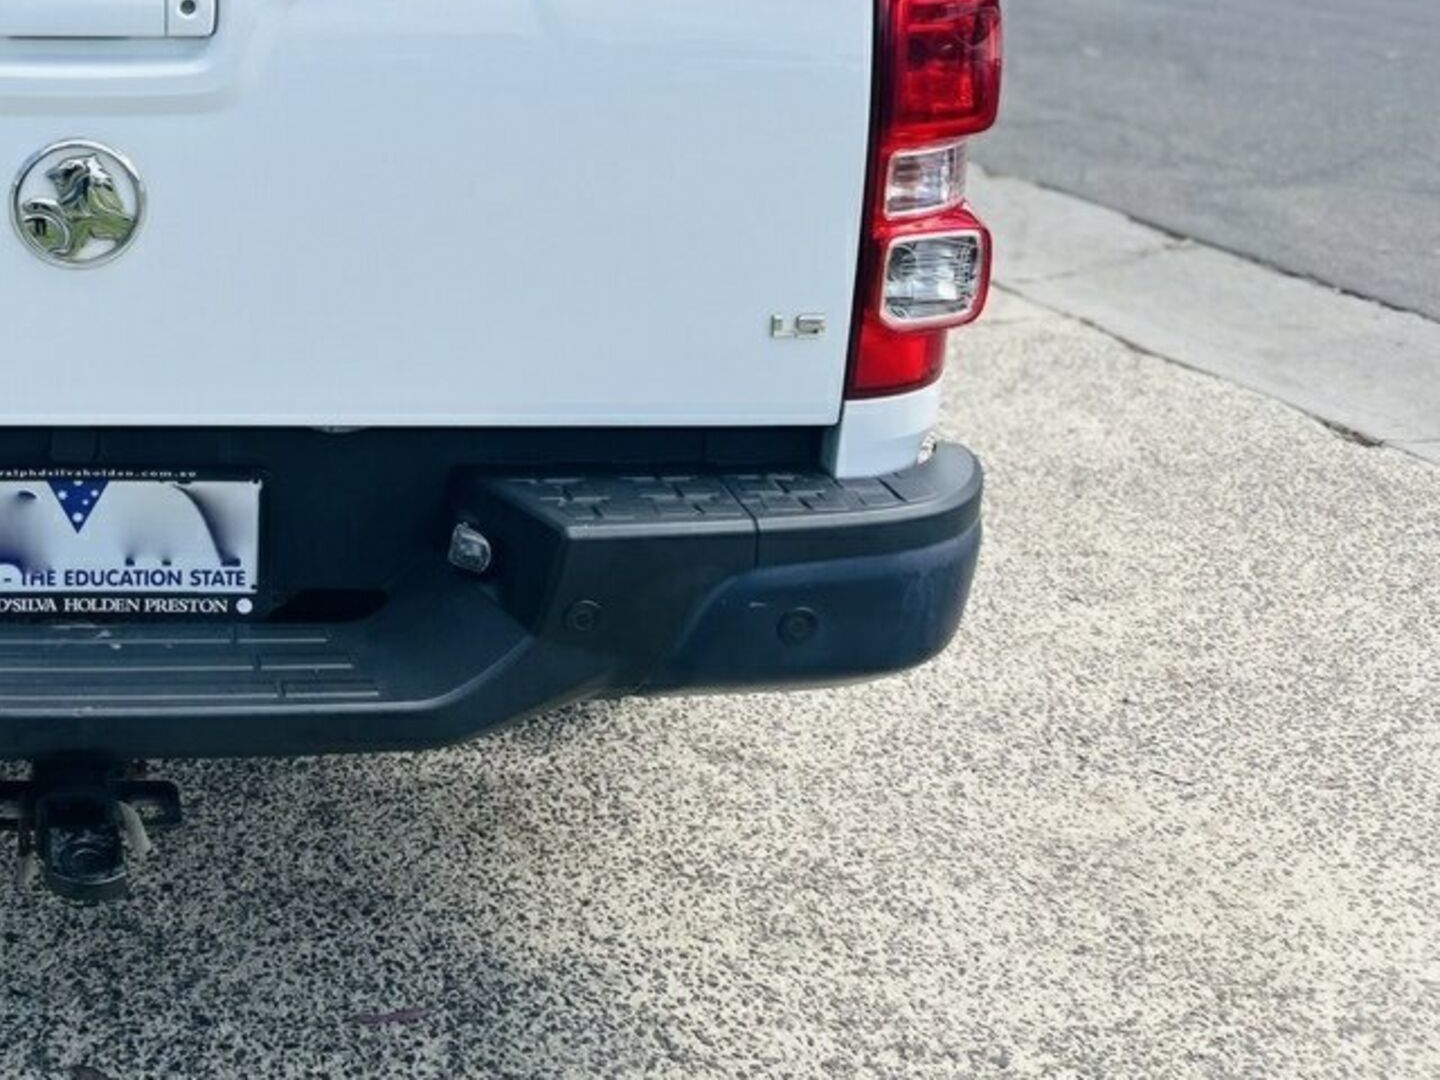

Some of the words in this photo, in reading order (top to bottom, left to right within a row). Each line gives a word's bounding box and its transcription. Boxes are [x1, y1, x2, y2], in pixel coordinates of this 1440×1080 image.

[769, 312, 827, 340] LS
[21, 569, 56, 587] THE
[64, 569, 182, 587] EDUCATION
[189, 569, 246, 587] STATE
[63, 597, 141, 613] HOLDEN
[144, 597, 229, 613] PRESTON
